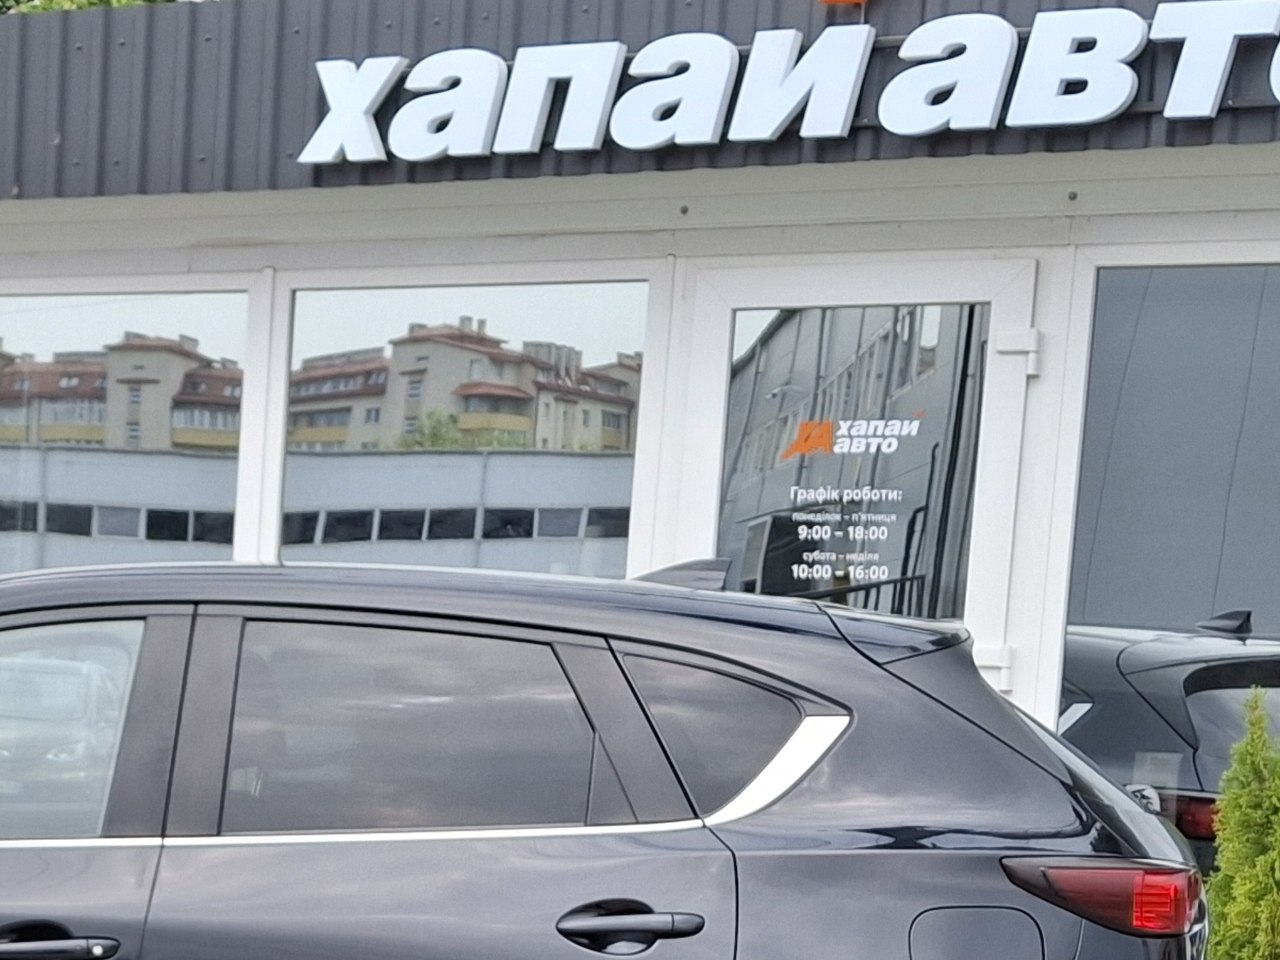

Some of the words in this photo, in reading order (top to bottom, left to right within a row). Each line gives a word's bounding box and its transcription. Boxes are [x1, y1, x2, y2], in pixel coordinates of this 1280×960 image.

[877, 0, 1280, 136] авт
[833, 437, 899, 454] авто
[790, 486, 840, 504] Графік
[842, 486, 903, 505] роботи:
[797, 524, 831, 540] 9:00
[847, 525, 889, 541] 18:00
[802, 549, 837, 562] субота
[791, 563, 832, 580] 10:00
[847, 565, 889, 580] 16:00
